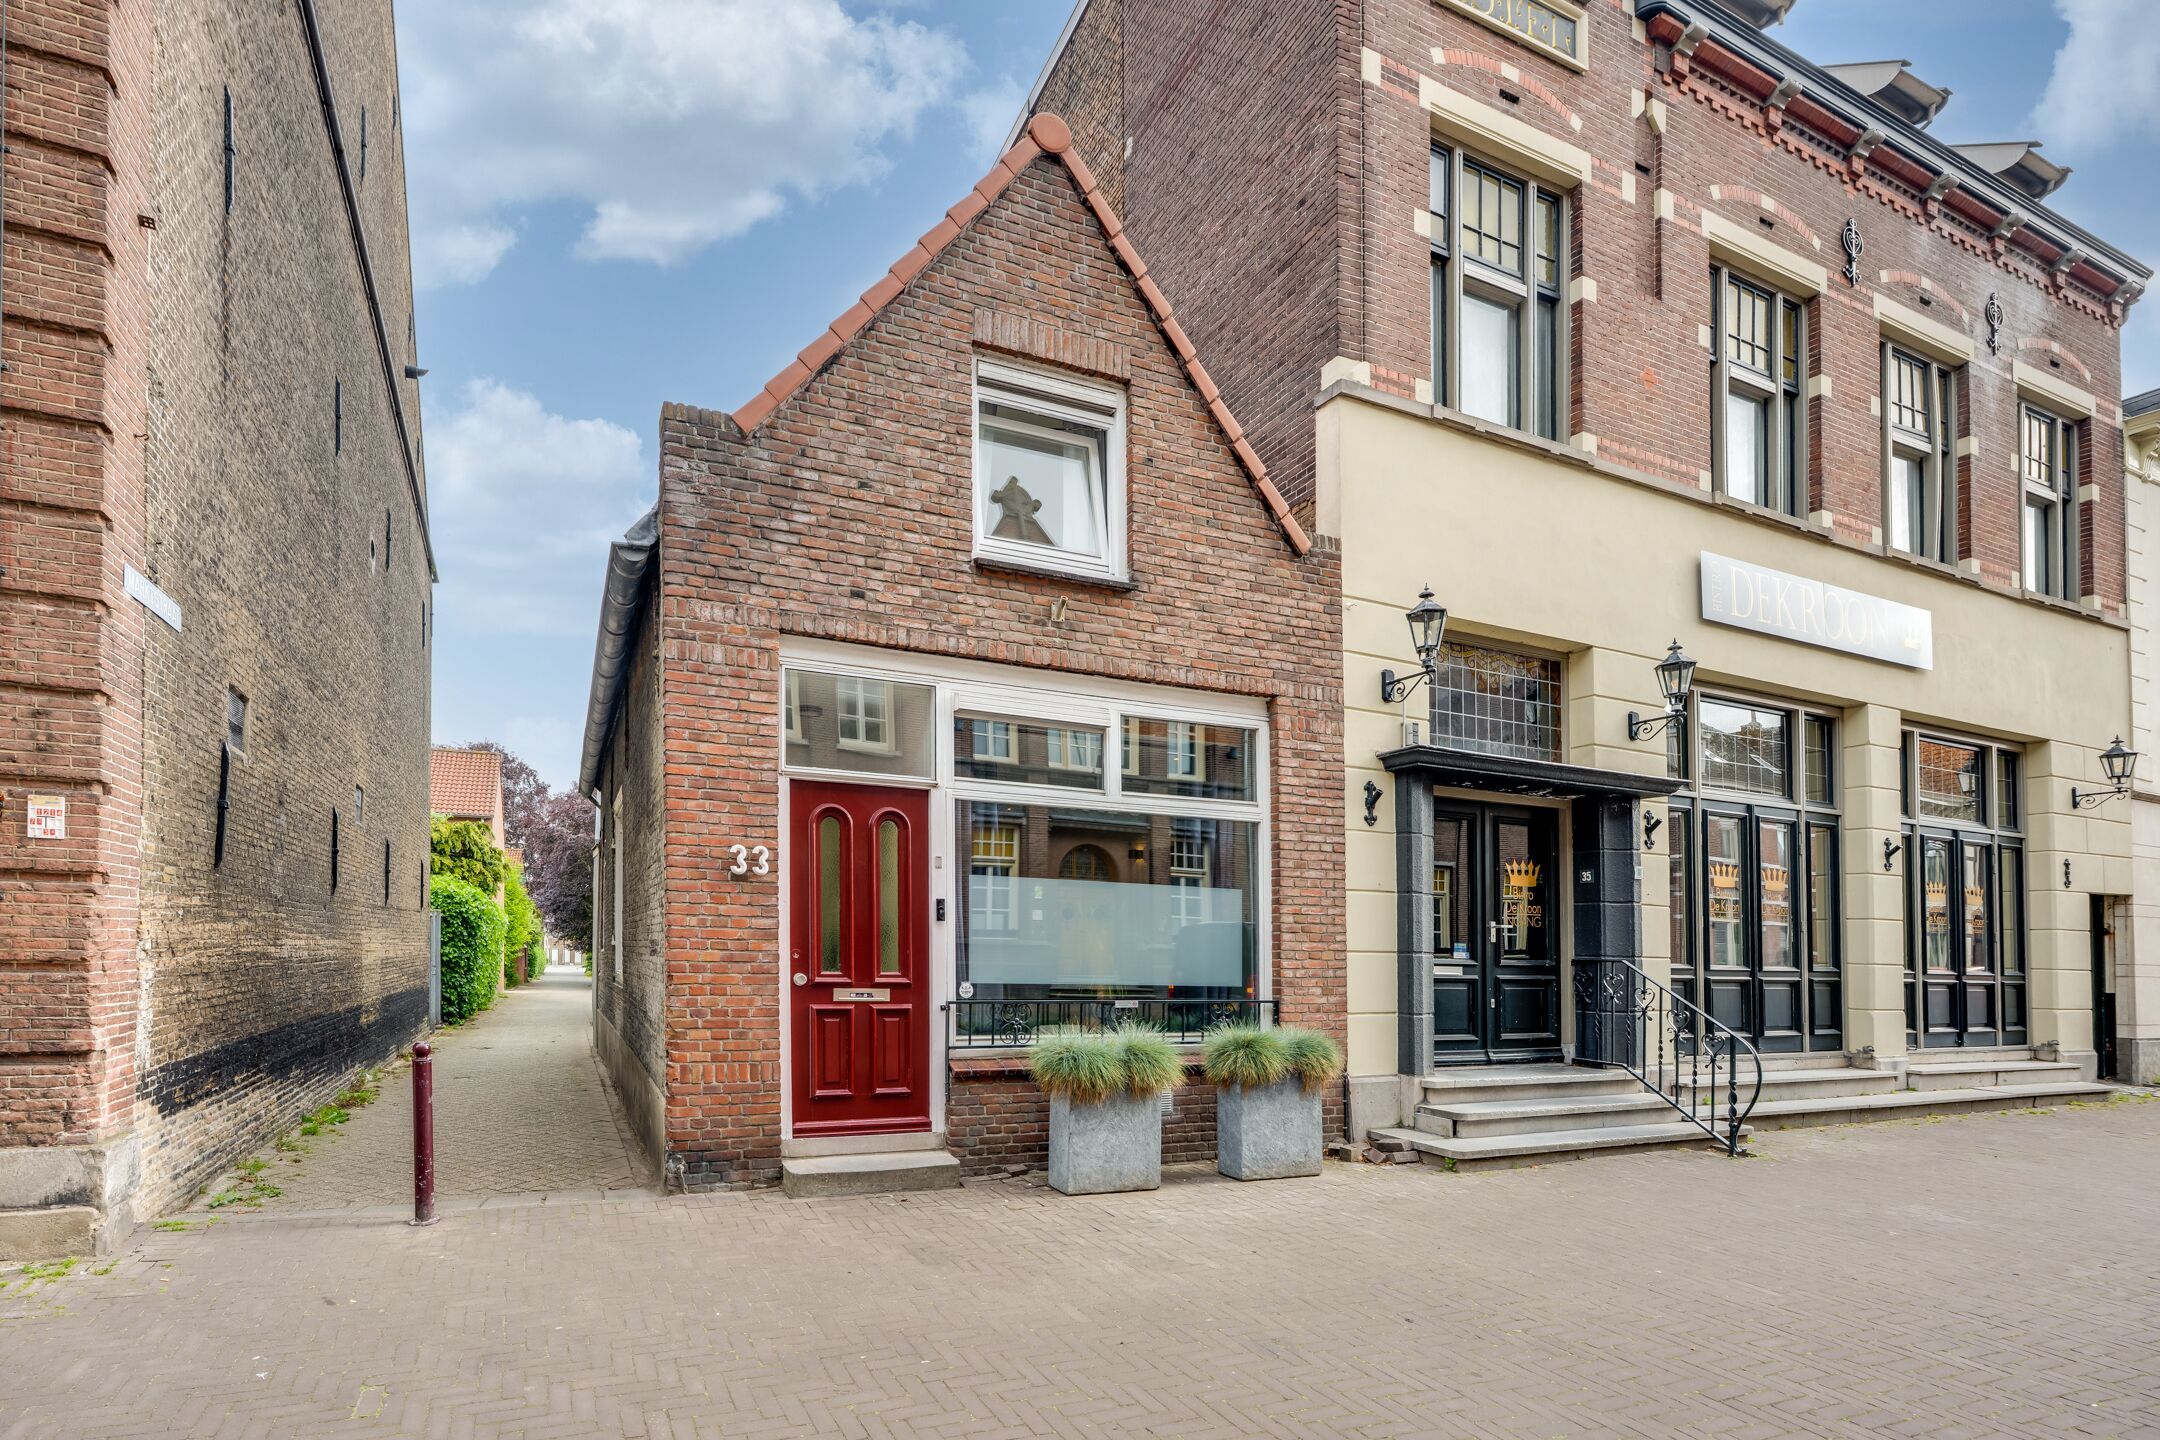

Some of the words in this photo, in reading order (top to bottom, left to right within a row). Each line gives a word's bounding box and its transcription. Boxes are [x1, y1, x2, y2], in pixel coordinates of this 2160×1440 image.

[1710, 560, 1723, 612] BISTRO
[730, 844, 769, 875] 33
[1581, 871, 1592, 882] 35
